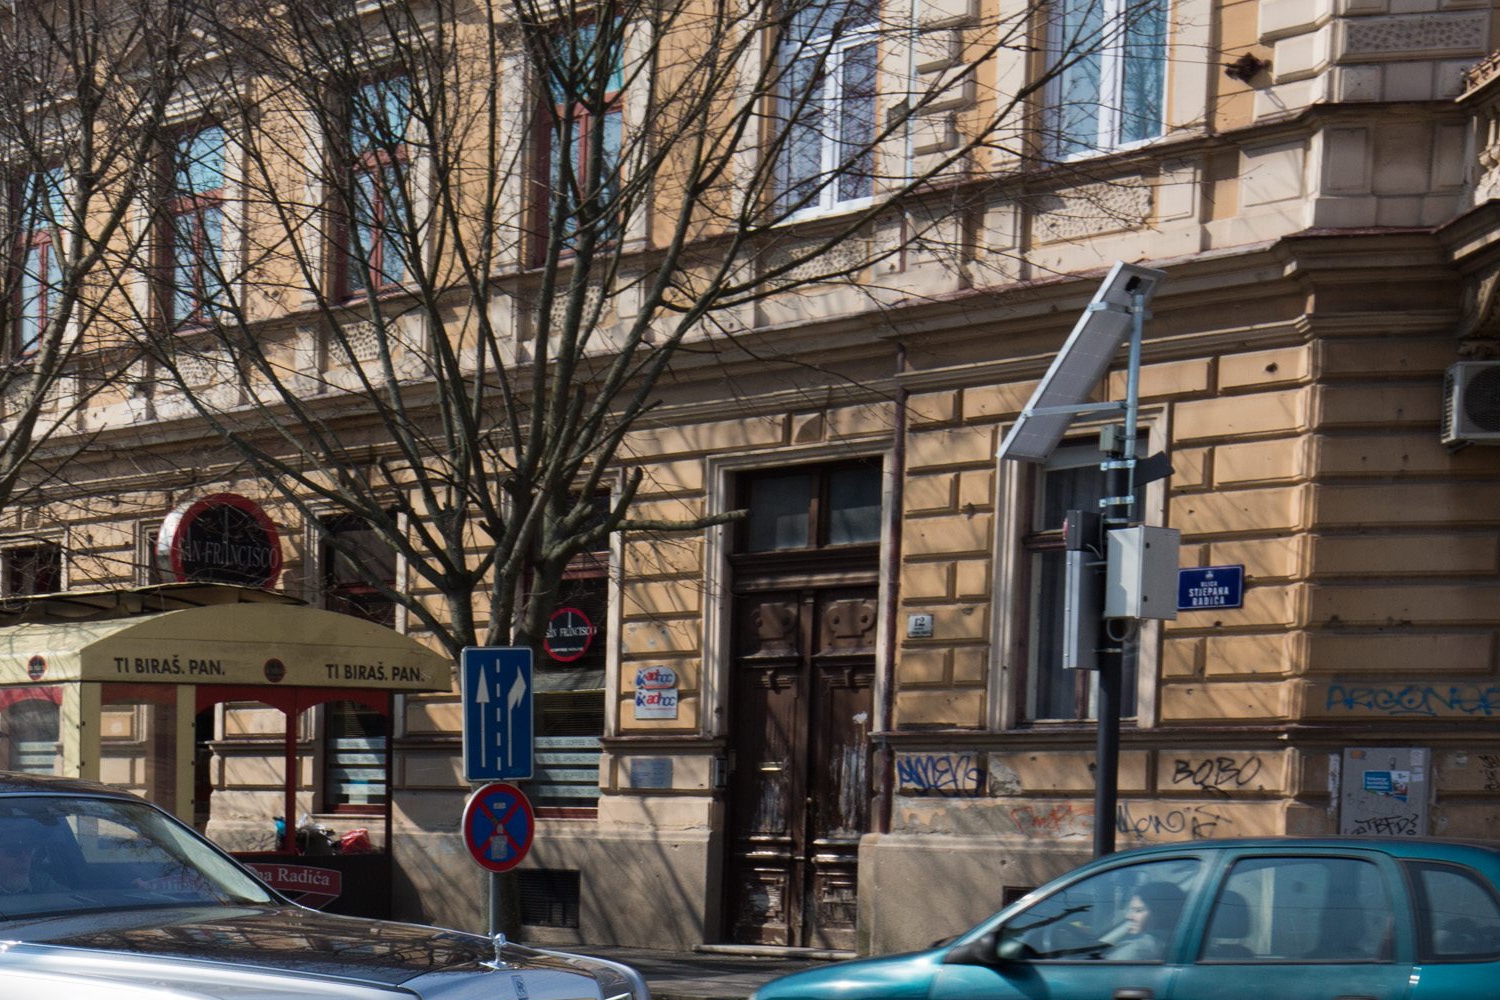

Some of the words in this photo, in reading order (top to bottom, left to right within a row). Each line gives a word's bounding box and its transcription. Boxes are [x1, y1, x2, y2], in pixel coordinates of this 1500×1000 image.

[1188, 586, 1229, 597] STJEPANA
[114, 657, 129, 673] TI
[135, 655, 185, 675] BIRAŠ.
[188, 660, 225, 676] PAN.
[325, 664, 339, 679] TI
[344, 662, 388, 681] BIRAŠ.
[392, 667, 425, 682] PAN.
[277, 867, 330, 886] Radića
